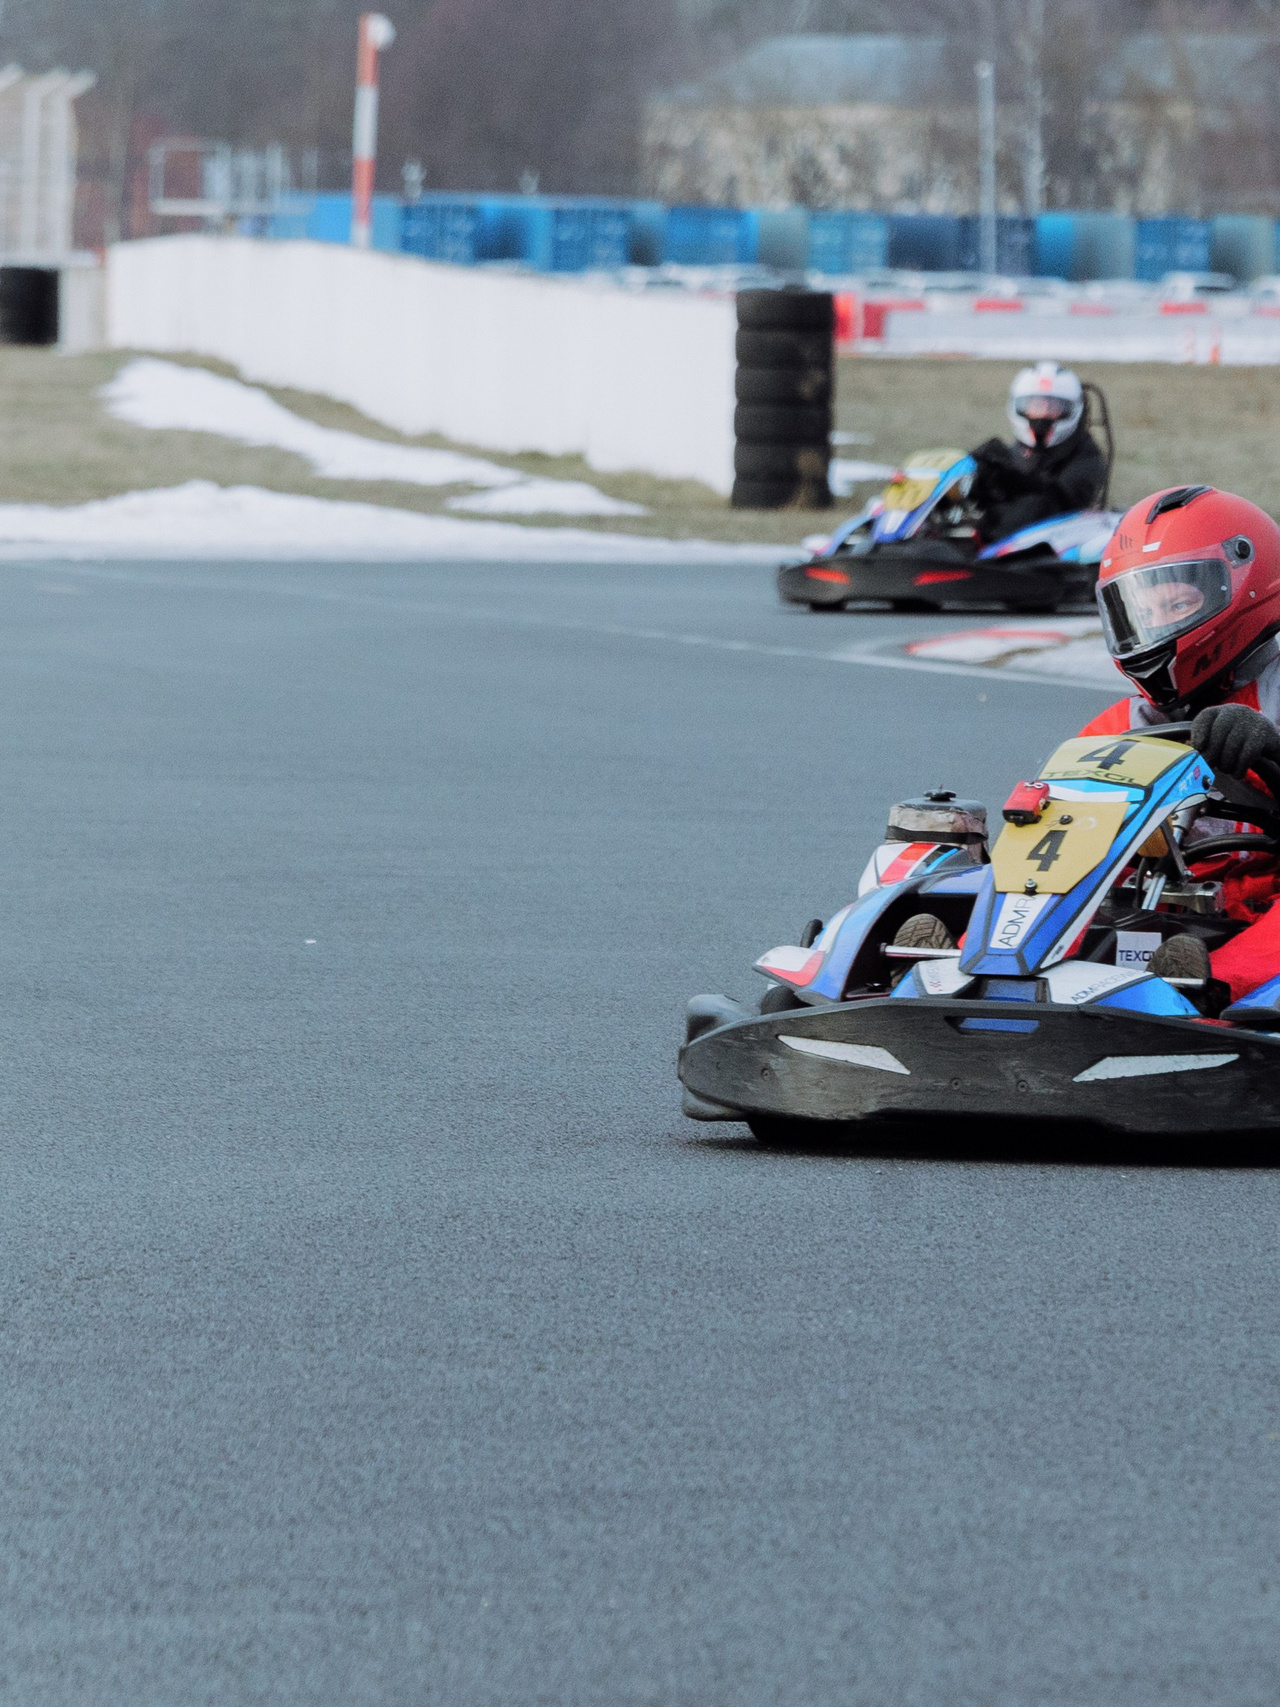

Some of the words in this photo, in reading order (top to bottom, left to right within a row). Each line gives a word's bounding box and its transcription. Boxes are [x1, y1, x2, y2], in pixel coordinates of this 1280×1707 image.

[1077, 738, 1141, 771] 4
[1043, 769, 1136, 784] TEXOL
[1025, 829, 1068, 872] 4
